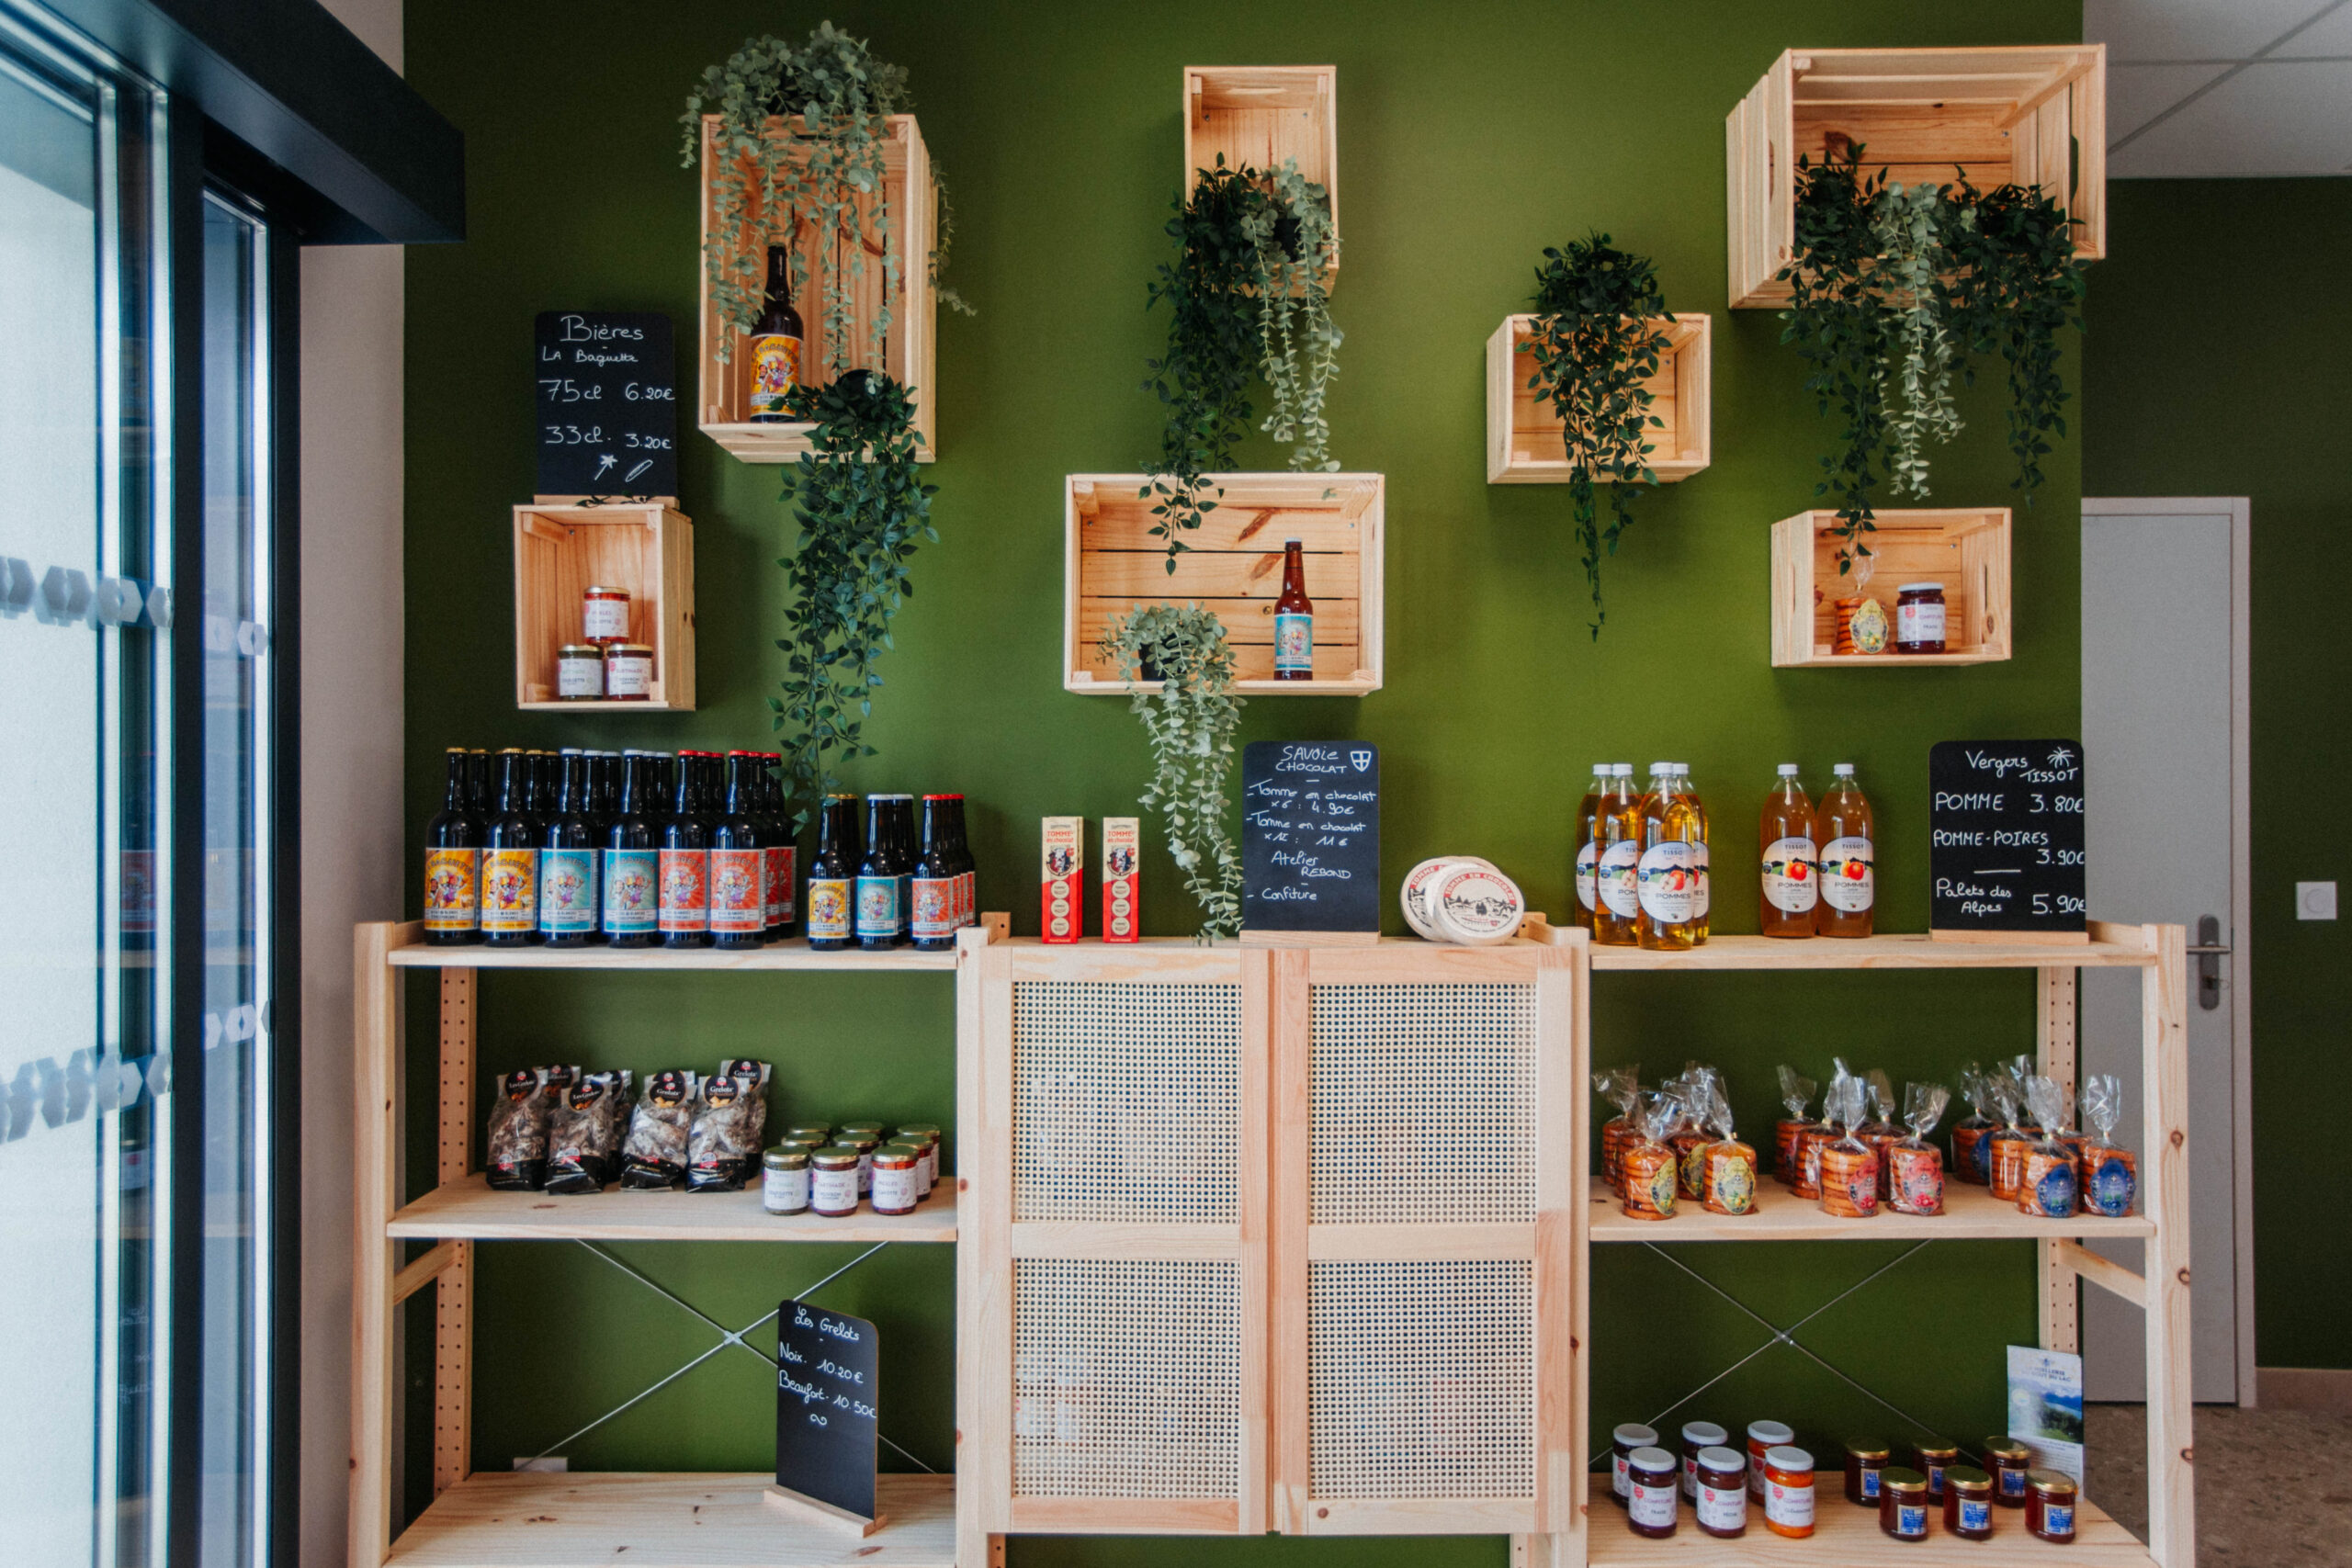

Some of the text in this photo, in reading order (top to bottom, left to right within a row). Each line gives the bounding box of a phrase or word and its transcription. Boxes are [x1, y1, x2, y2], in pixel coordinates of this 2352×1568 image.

[560, 315, 645, 343] Bières
[542, 345, 639, 367] LA Baguette
[1275, 761, 1348, 773] CHOCOLAT
[1965, 750, 2029, 778] Vergers
[2019, 767, 2078, 783] TISSOT
[1249, 779, 1376, 802] Tomme en chocolat
[1935, 792, 2005, 812] POMME
[1250, 809, 1366, 832] Tomme en chocolat
[1271, 851, 1318, 866] Atelier
[1301, 867, 1351, 879] REBOND
[1261, 886, 1317, 901] Confiture
[1989, 886, 2012, 897] des
[1961, 901, 2002, 917] Alpes
[820, 1317, 860, 1341] Grelots
